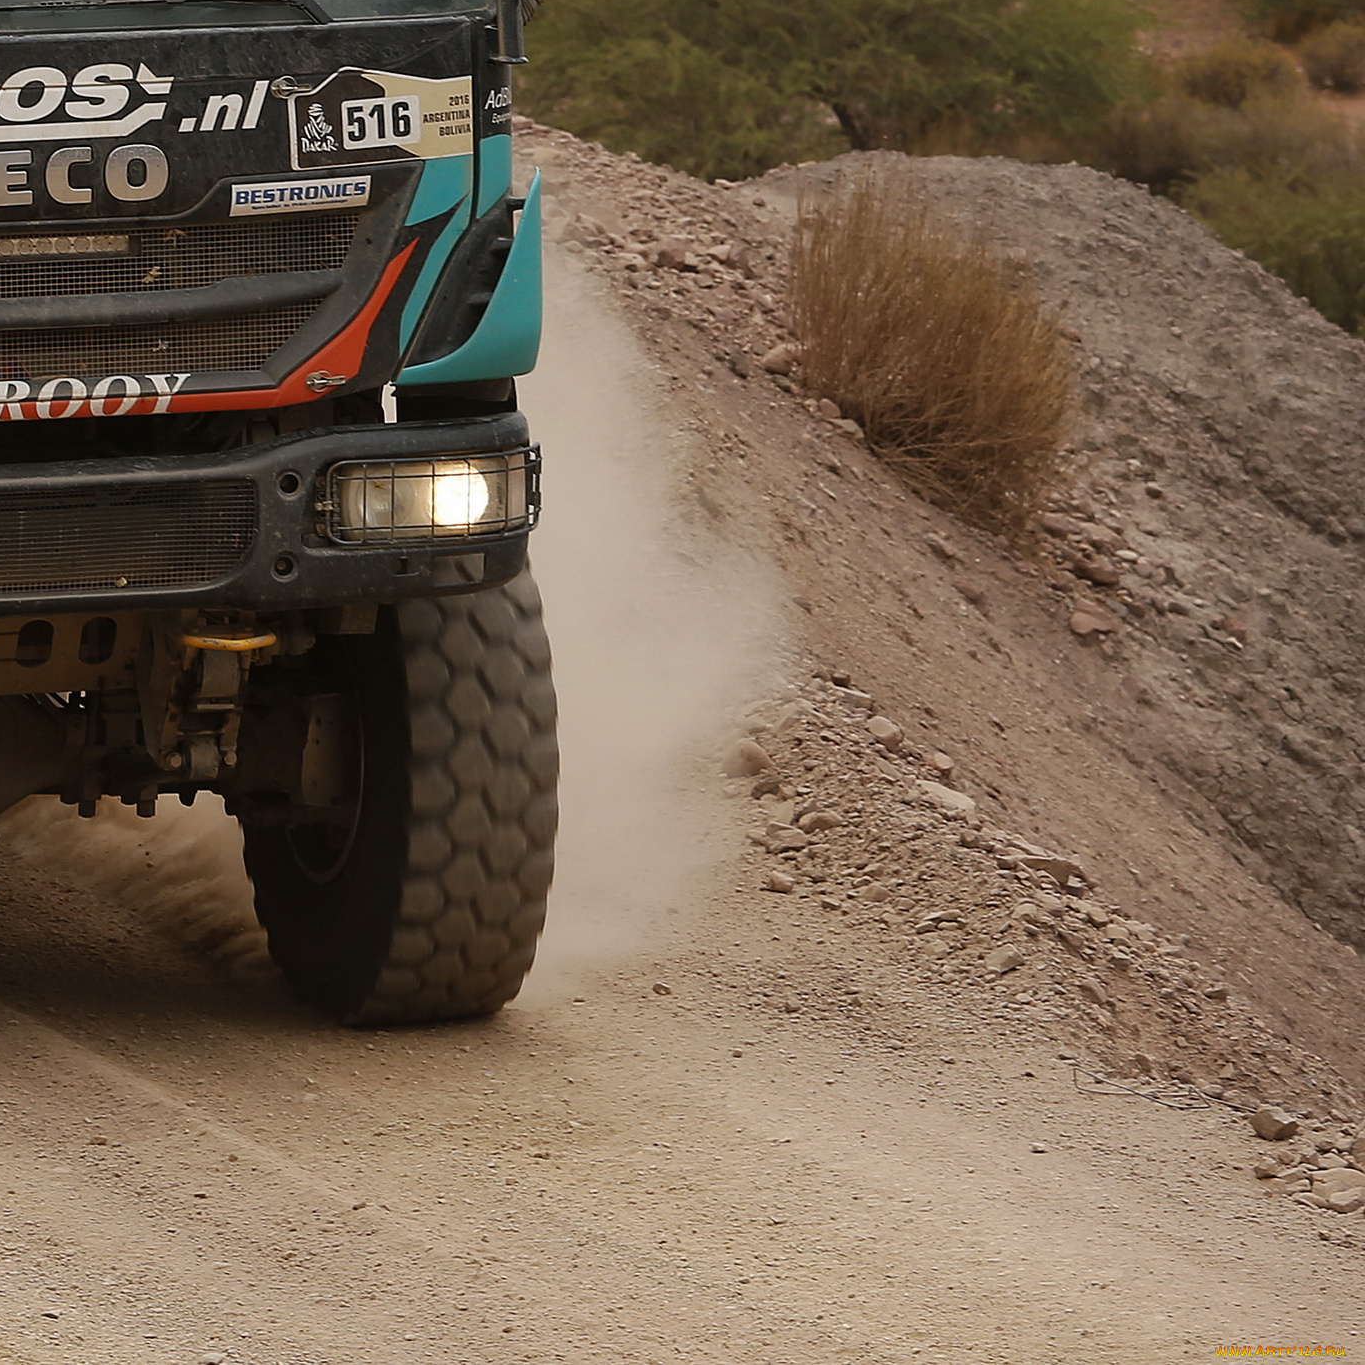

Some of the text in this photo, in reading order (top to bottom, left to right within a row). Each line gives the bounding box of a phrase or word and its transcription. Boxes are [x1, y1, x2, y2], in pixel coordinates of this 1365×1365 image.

[346, 101, 411, 142] 516
[423, 109, 472, 124] ARGENTINA
[439, 123, 472, 137] BOLIVIA
[236, 181, 367, 205] BESTRONICS
